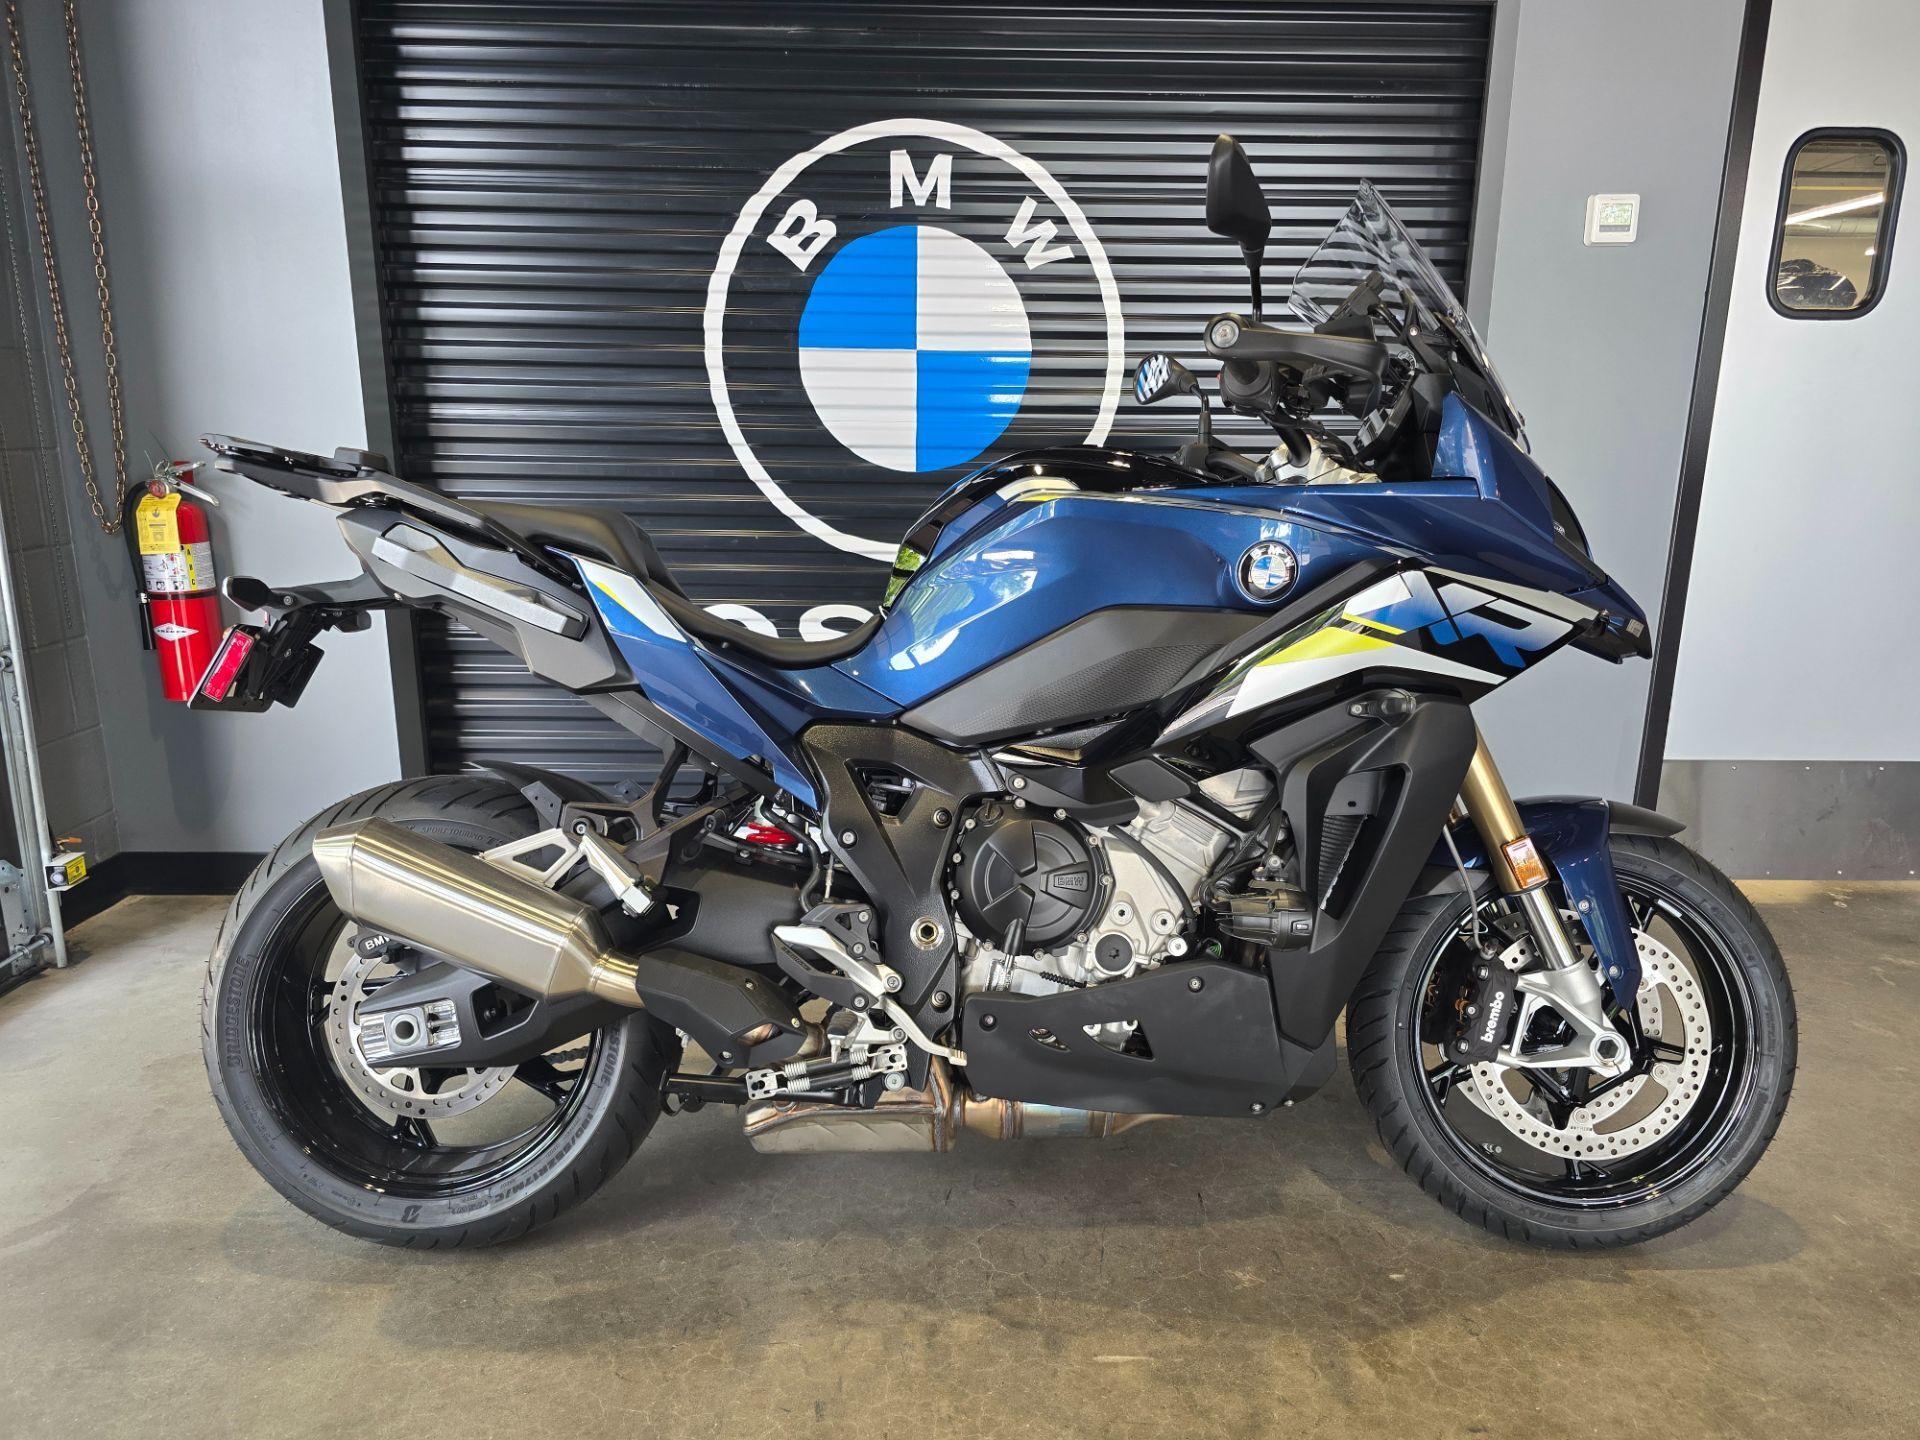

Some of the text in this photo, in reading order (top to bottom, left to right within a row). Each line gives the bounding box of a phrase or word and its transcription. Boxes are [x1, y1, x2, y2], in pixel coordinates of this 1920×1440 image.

[766, 149, 1076, 273] BMW
[1249, 543, 1296, 568] BMW
[1057, 876, 1085, 886] BMW
[1480, 991, 1505, 1043] brembo
